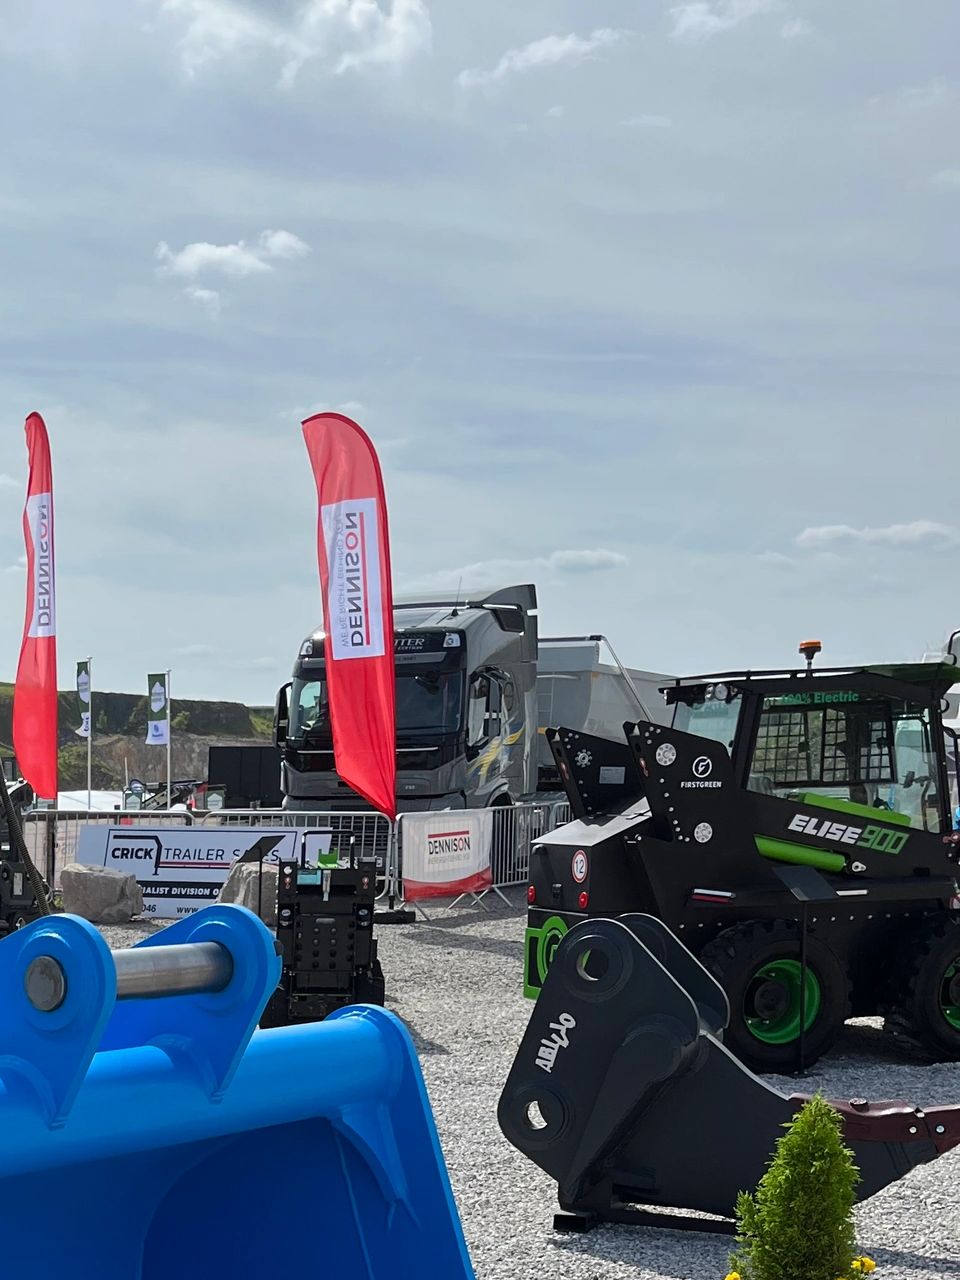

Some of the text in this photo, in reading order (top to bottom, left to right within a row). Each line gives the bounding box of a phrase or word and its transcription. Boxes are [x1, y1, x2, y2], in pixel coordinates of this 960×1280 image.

[814, 691, 859, 704] Electric
[680, 781, 722, 789] FIRSTGREEN
[428, 836, 471, 855] DENNISON
[111, 847, 153, 860] CRICK
[164, 847, 224, 861] TRAILER
[575, 859, 585, 874] 12
[142, 886, 220, 896] IALIST DIVISION O
[142, 904, 199, 914] 046 www
